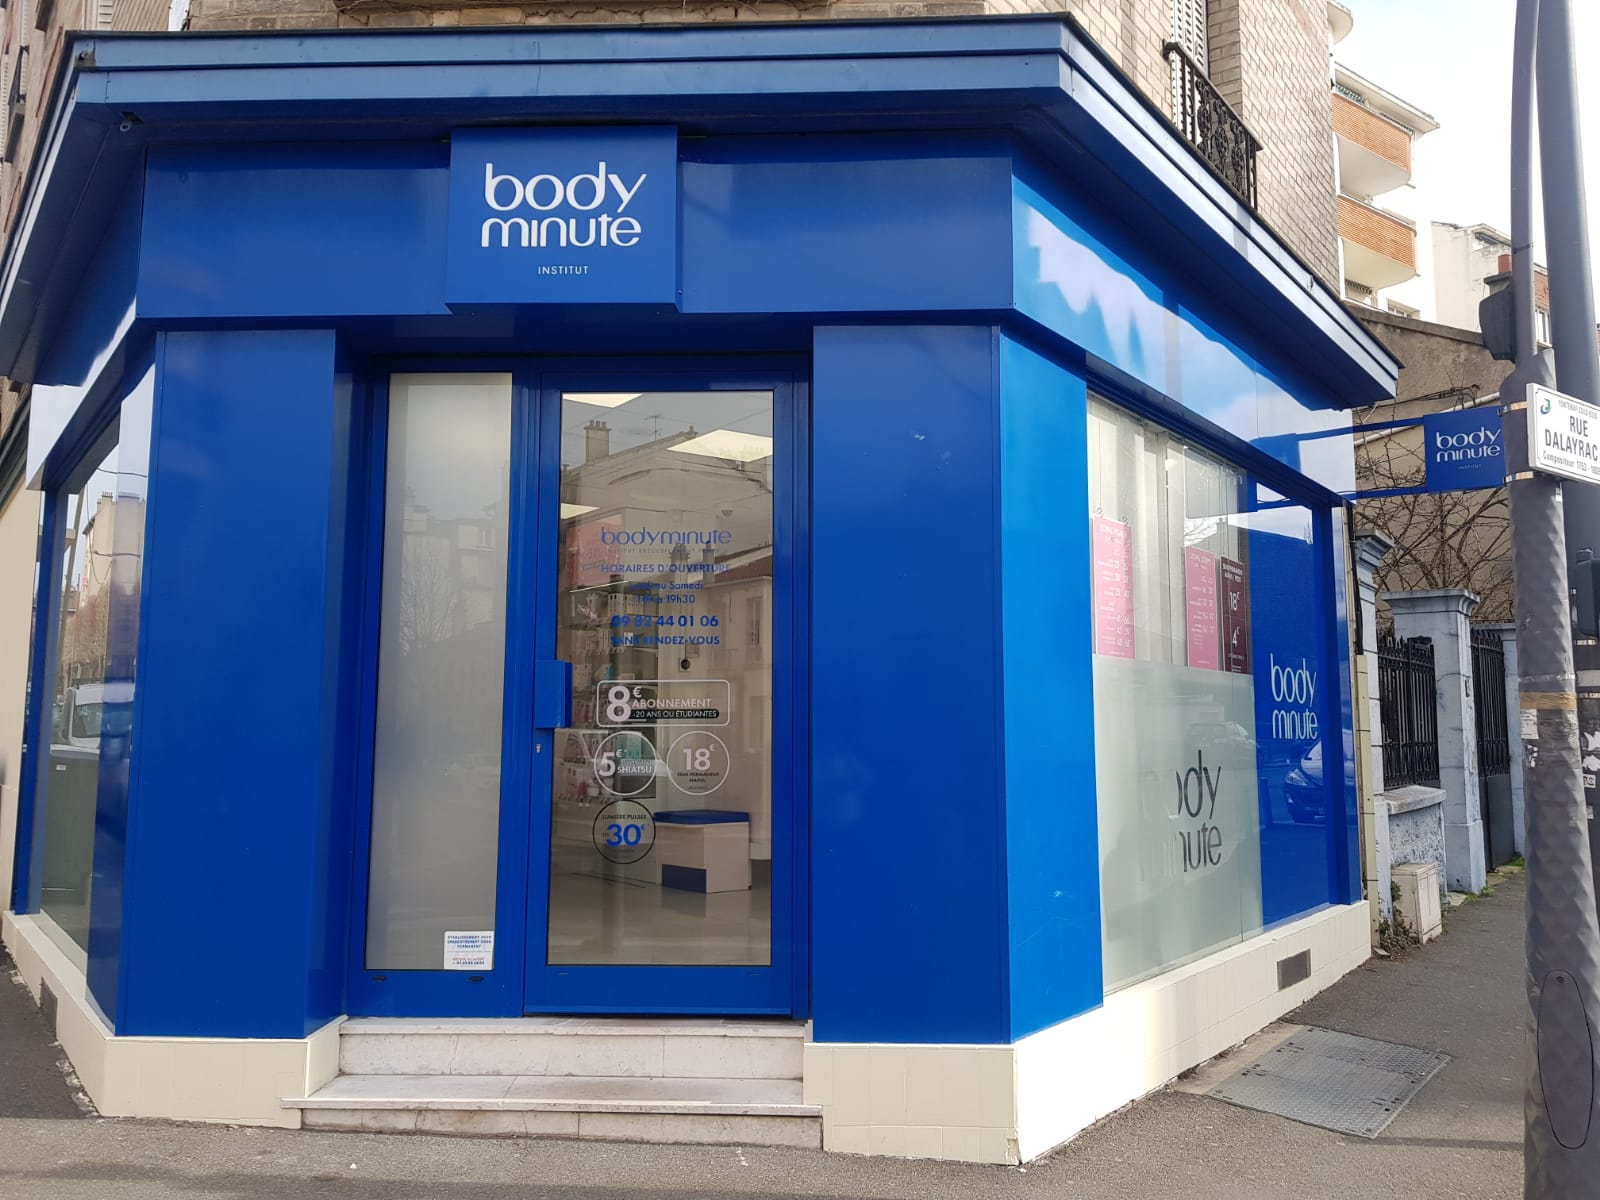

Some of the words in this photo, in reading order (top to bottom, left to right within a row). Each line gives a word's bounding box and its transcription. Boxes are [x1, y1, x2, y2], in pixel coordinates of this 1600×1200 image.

[485, 161, 648, 213] body
[481, 213, 642, 247] minute
[538, 265, 589, 275] INSTITUT
[1569, 415, 1589, 438] RUE
[1436, 426, 1501, 450] body
[1545, 428, 1598, 462] DALAYRAC
[1436, 444, 1500, 463] minute
[1543, 450, 1575, 468] Compositeur
[601, 527, 732, 545] bodyminute
[601, 564, 654, 574] HORAIRES
[669, 580, 704, 590] Samedi
[666, 594, 696, 604] 19h30
[1270, 652, 1317, 707] body
[631, 698, 712, 709] ABONNEMENT
[646, 710, 661, 718] ANS
[663, 710, 674, 718] OU
[1272, 708, 1318, 740] minute
[617, 765, 652, 774] SHIATSU
